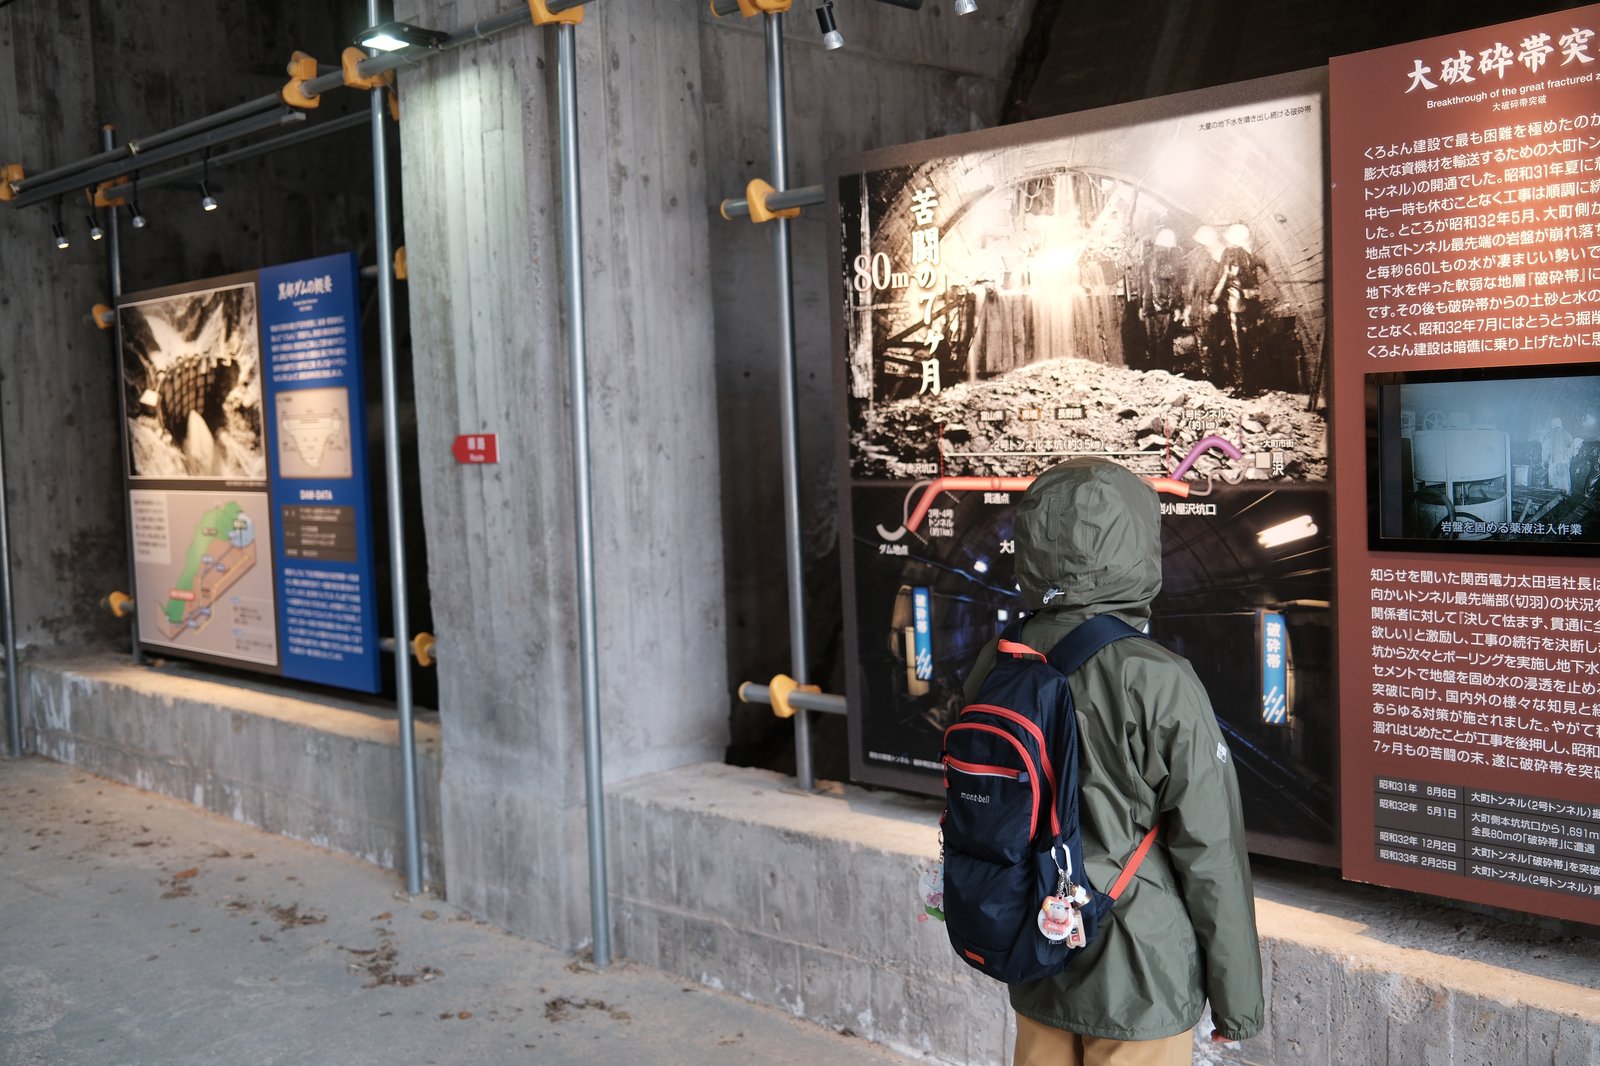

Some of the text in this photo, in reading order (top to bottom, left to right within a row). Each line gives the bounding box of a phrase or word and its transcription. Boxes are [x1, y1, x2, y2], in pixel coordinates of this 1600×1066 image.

[1404, 27, 1600, 94] 大破砕帯突
[1427, 92, 1488, 109] Breakthrough
[1490, 89, 1501, 99] of
[1502, 86, 1518, 97] the
[1519, 82, 1545, 96] great
[1547, 73, 1593, 89] fractured
[854, 252, 909, 292] 80m
[1441, 521, 1582, 536] 岩盤を固める薬液注入作業
[1371, 626, 1600, 654] 欲しい』と激励し、工事の続行を決断し
[1372, 664, 1600, 695] セメントで地盤を固め水の浸透を止め
[1426, 786, 1456, 799] 8月6日
[1427, 806, 1457, 819] 5月1日
[1422, 838, 1456, 853] 12月2日
[1421, 856, 1457, 871] 2月25日
